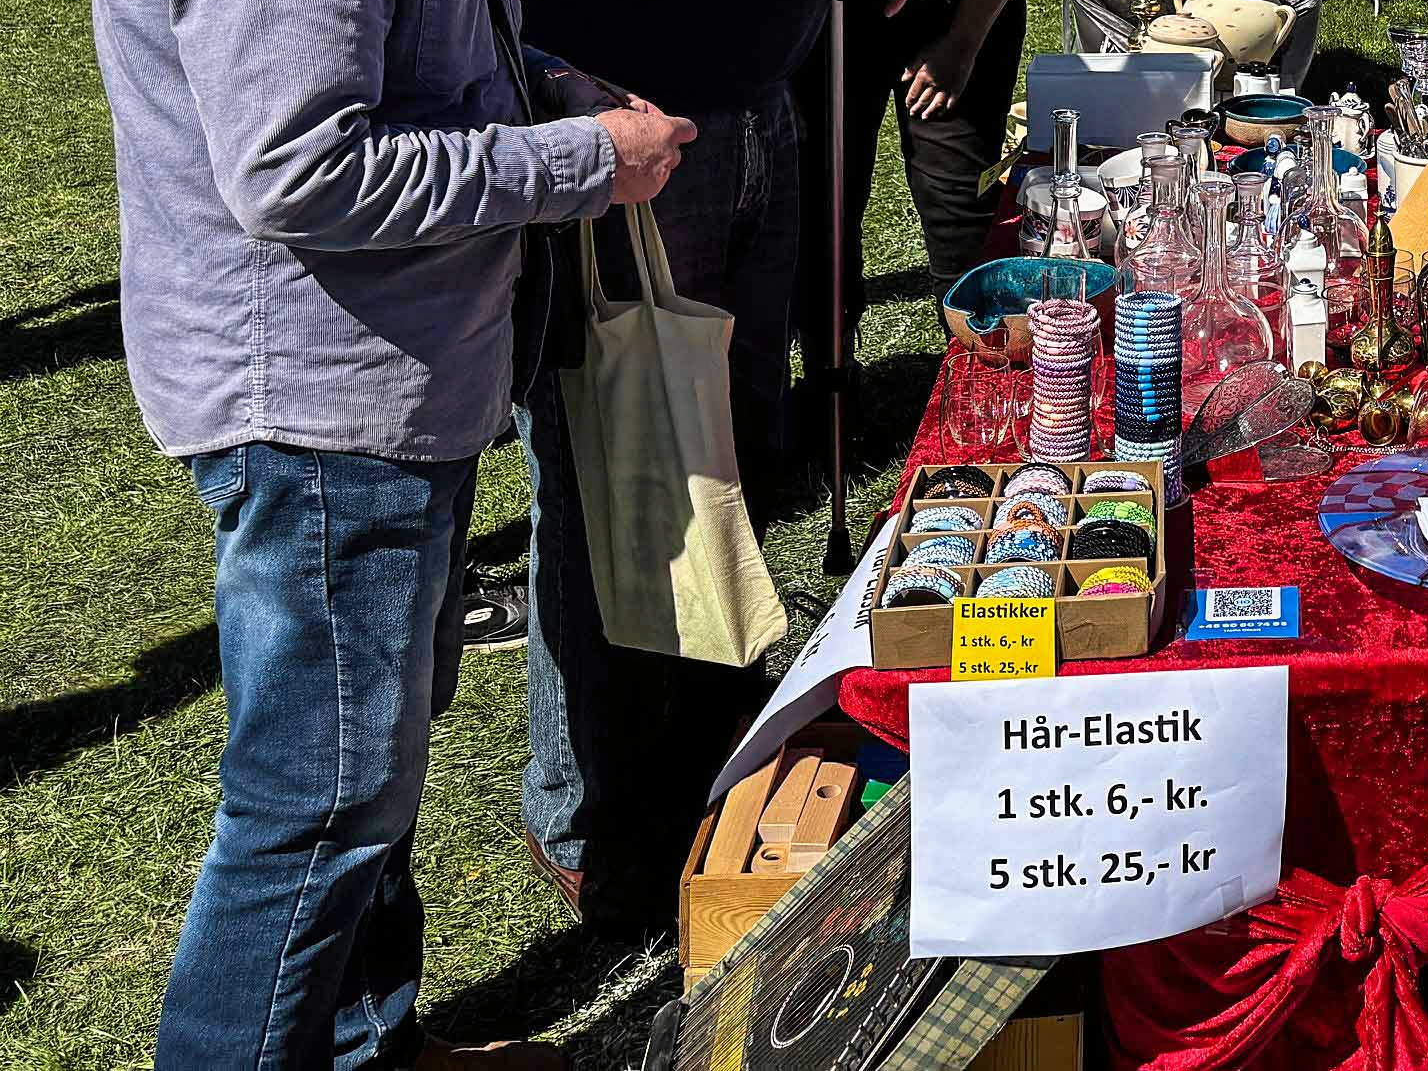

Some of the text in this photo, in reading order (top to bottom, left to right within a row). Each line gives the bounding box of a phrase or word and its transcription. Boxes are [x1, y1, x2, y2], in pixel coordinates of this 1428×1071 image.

[961, 603, 1048, 619] Elastikker
[960, 635, 1035, 649] 1 stk. 6,- kr
[959, 662, 966, 673] 5
[971, 662, 995, 674] stk.
[1003, 709, 1203, 751] Hår-Elastik
[998, 779, 1208, 820] 1 stk. 6,- kr.
[989, 843, 1217, 890] 5 stk. 25,- kr
